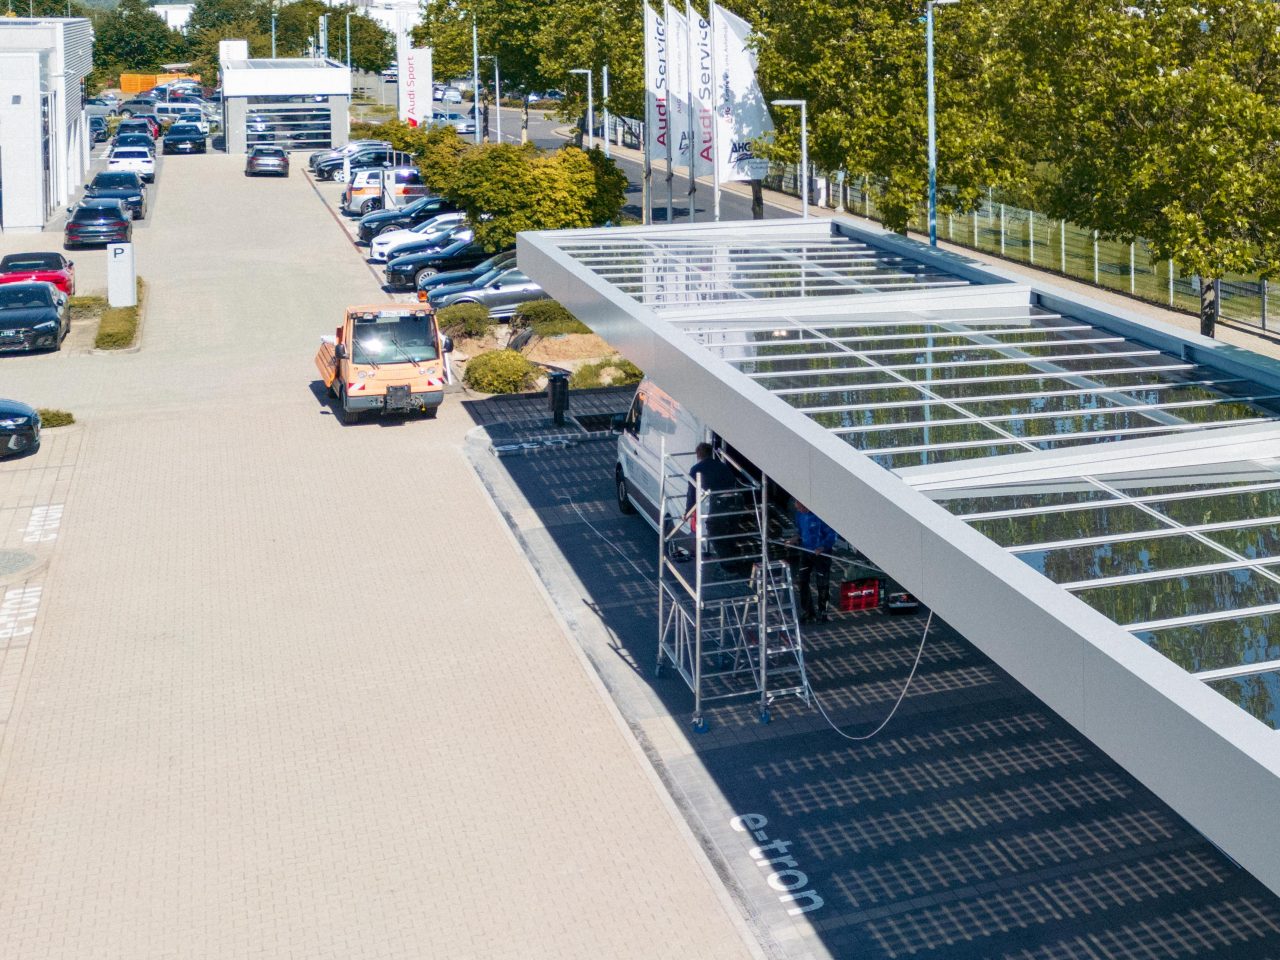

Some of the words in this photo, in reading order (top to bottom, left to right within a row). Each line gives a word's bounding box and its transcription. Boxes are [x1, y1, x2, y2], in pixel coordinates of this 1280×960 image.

[406, 56, 416, 87] Sport
[407, 91, 416, 115] Audi
[656, 97, 667, 146] Audi
[700, 108, 713, 162] Audi
[113, 247, 125, 259] P
[730, 812, 825, 917] e-tron
